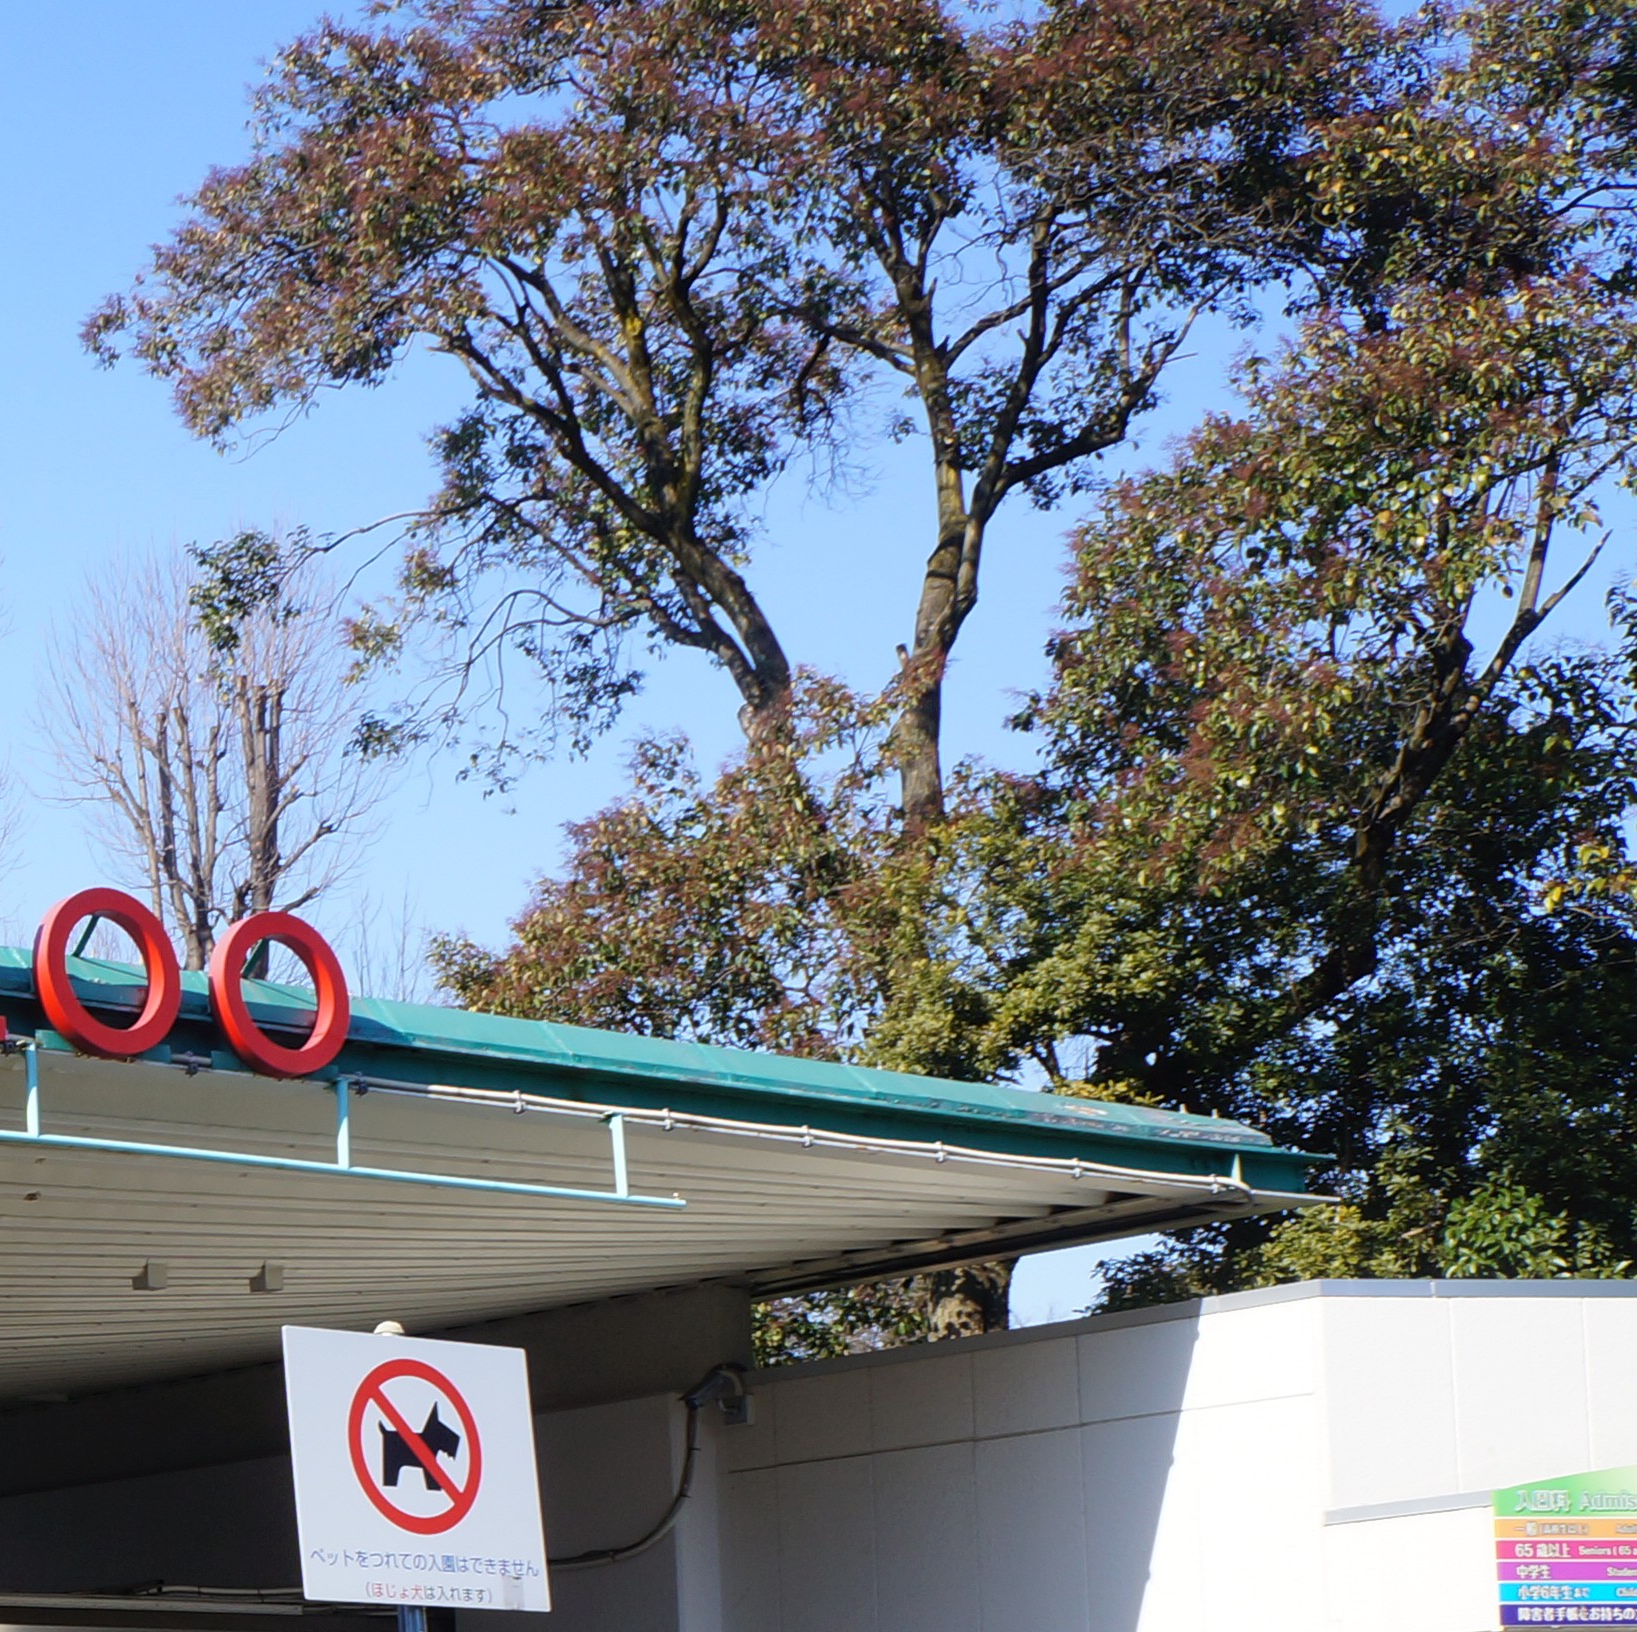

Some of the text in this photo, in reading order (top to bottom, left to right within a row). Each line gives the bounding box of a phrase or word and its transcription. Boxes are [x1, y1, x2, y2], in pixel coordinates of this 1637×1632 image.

[1515, 1544, 1533, 1557] 65
[311, 1548, 539, 1577] ペットをつれての入園はできません
[365, 1582, 492, 1603] (ほじょ犬は入れます)
